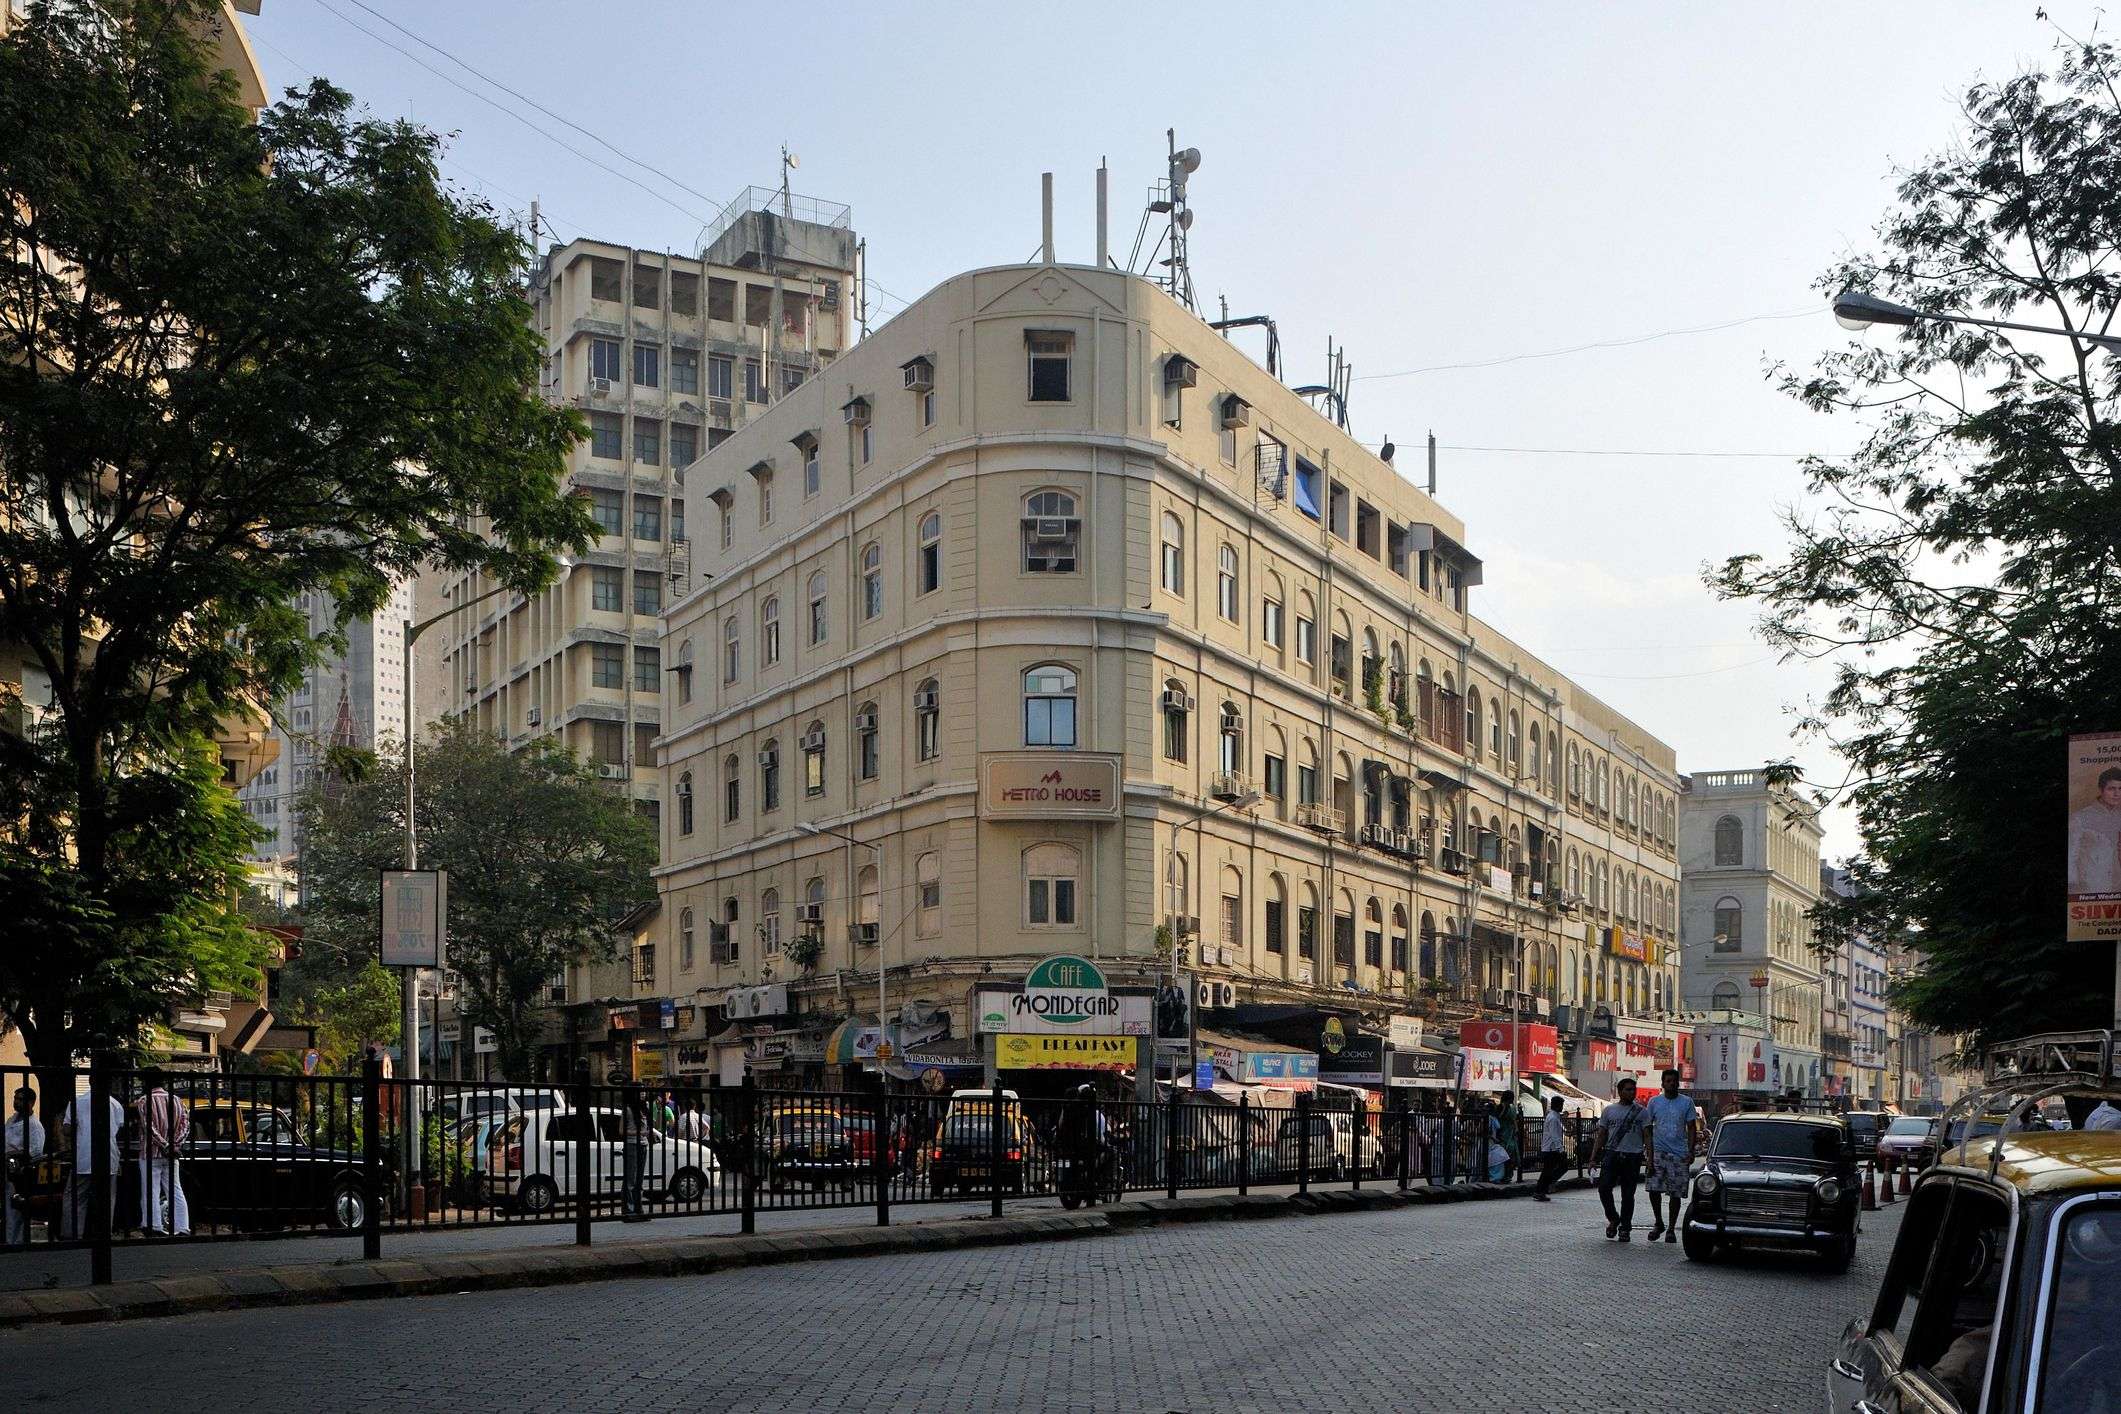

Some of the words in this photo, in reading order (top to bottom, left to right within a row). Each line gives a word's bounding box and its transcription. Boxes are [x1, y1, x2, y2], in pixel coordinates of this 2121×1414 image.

[1002, 787, 1049, 802] METRO
[1055, 788, 1102, 801] HOUSE
[1048, 962, 1082, 987] CAFE
[1012, 994, 1119, 1016] MONDEGAR
[1043, 1039, 1127, 1051] BREAKFAST
[1720, 1036, 1728, 1081] METRO
